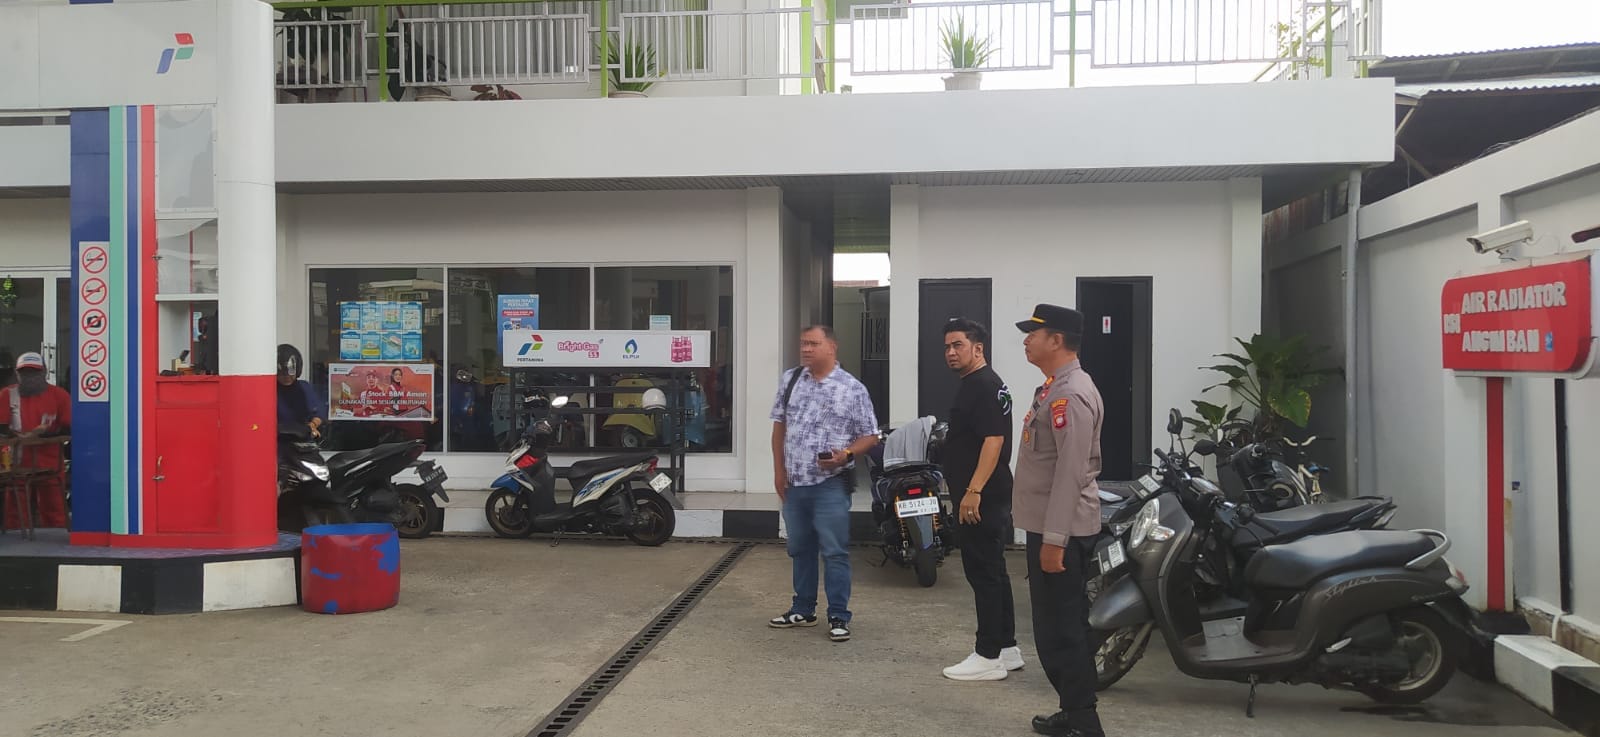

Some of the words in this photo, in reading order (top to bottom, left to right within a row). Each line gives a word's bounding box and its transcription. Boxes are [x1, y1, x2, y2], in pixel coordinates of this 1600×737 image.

[1462, 292, 1486, 314] AIR
[1487, 282, 1567, 312] RADIATOR
[558, 341, 582, 352] Bright
[582, 341, 599, 350] Gas
[1462, 330, 1505, 352] ANGIN
[1507, 329, 1539, 352] BAN
